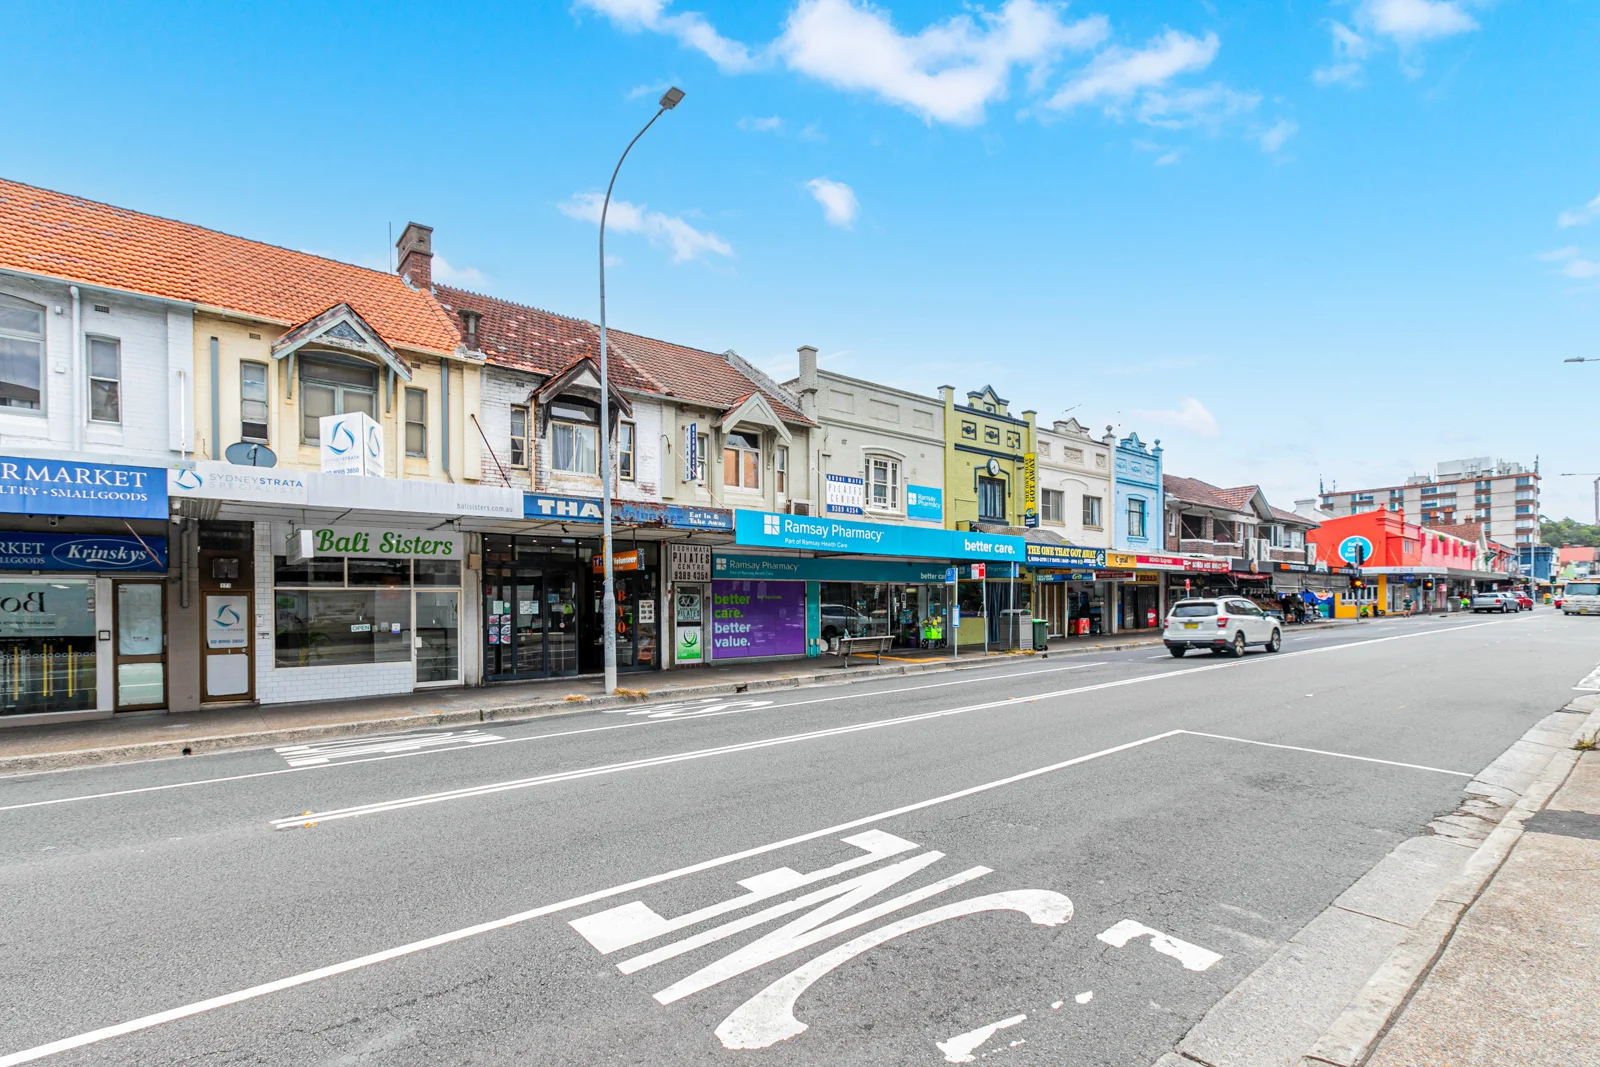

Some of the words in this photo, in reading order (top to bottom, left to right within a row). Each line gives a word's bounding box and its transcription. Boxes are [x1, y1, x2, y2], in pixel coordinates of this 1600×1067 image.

[50, 488, 148, 501] SMALLGOODS
[918, 493, 937, 503] Ramsay
[456, 503, 513, 513] balisisters.com.au
[538, 499, 603, 518] THA
[689, 511, 701, 519] Eat
[918, 500, 942, 510] Pharmacy
[784, 519, 829, 538] Ramsay
[831, 524, 883, 543] Pharmacy
[315, 529, 370, 553] Bali
[379, 531, 453, 555] Sisters
[965, 539, 992, 553] better
[994, 543, 1016, 554] care.
[67, 544, 147, 565] Krinskys
[1027, 545, 1040, 554] THE
[1041, 546, 1054, 556] ONE
[1055, 547, 1069, 557] THAT
[1070, 548, 1082, 558] GOT
[1082, 549, 1096, 558] AWAY
[672, 552, 710, 564] PILATES
[677, 563, 705, 571] CENTRE
[729, 560, 760, 571] Ramsay
[762, 561, 799, 572] Pharmacy
[920, 572, 937, 580] better
[713, 593, 750, 605] better
[713, 609, 744, 619] care.
[714, 622, 751, 633] better
[714, 635, 751, 648] value.
